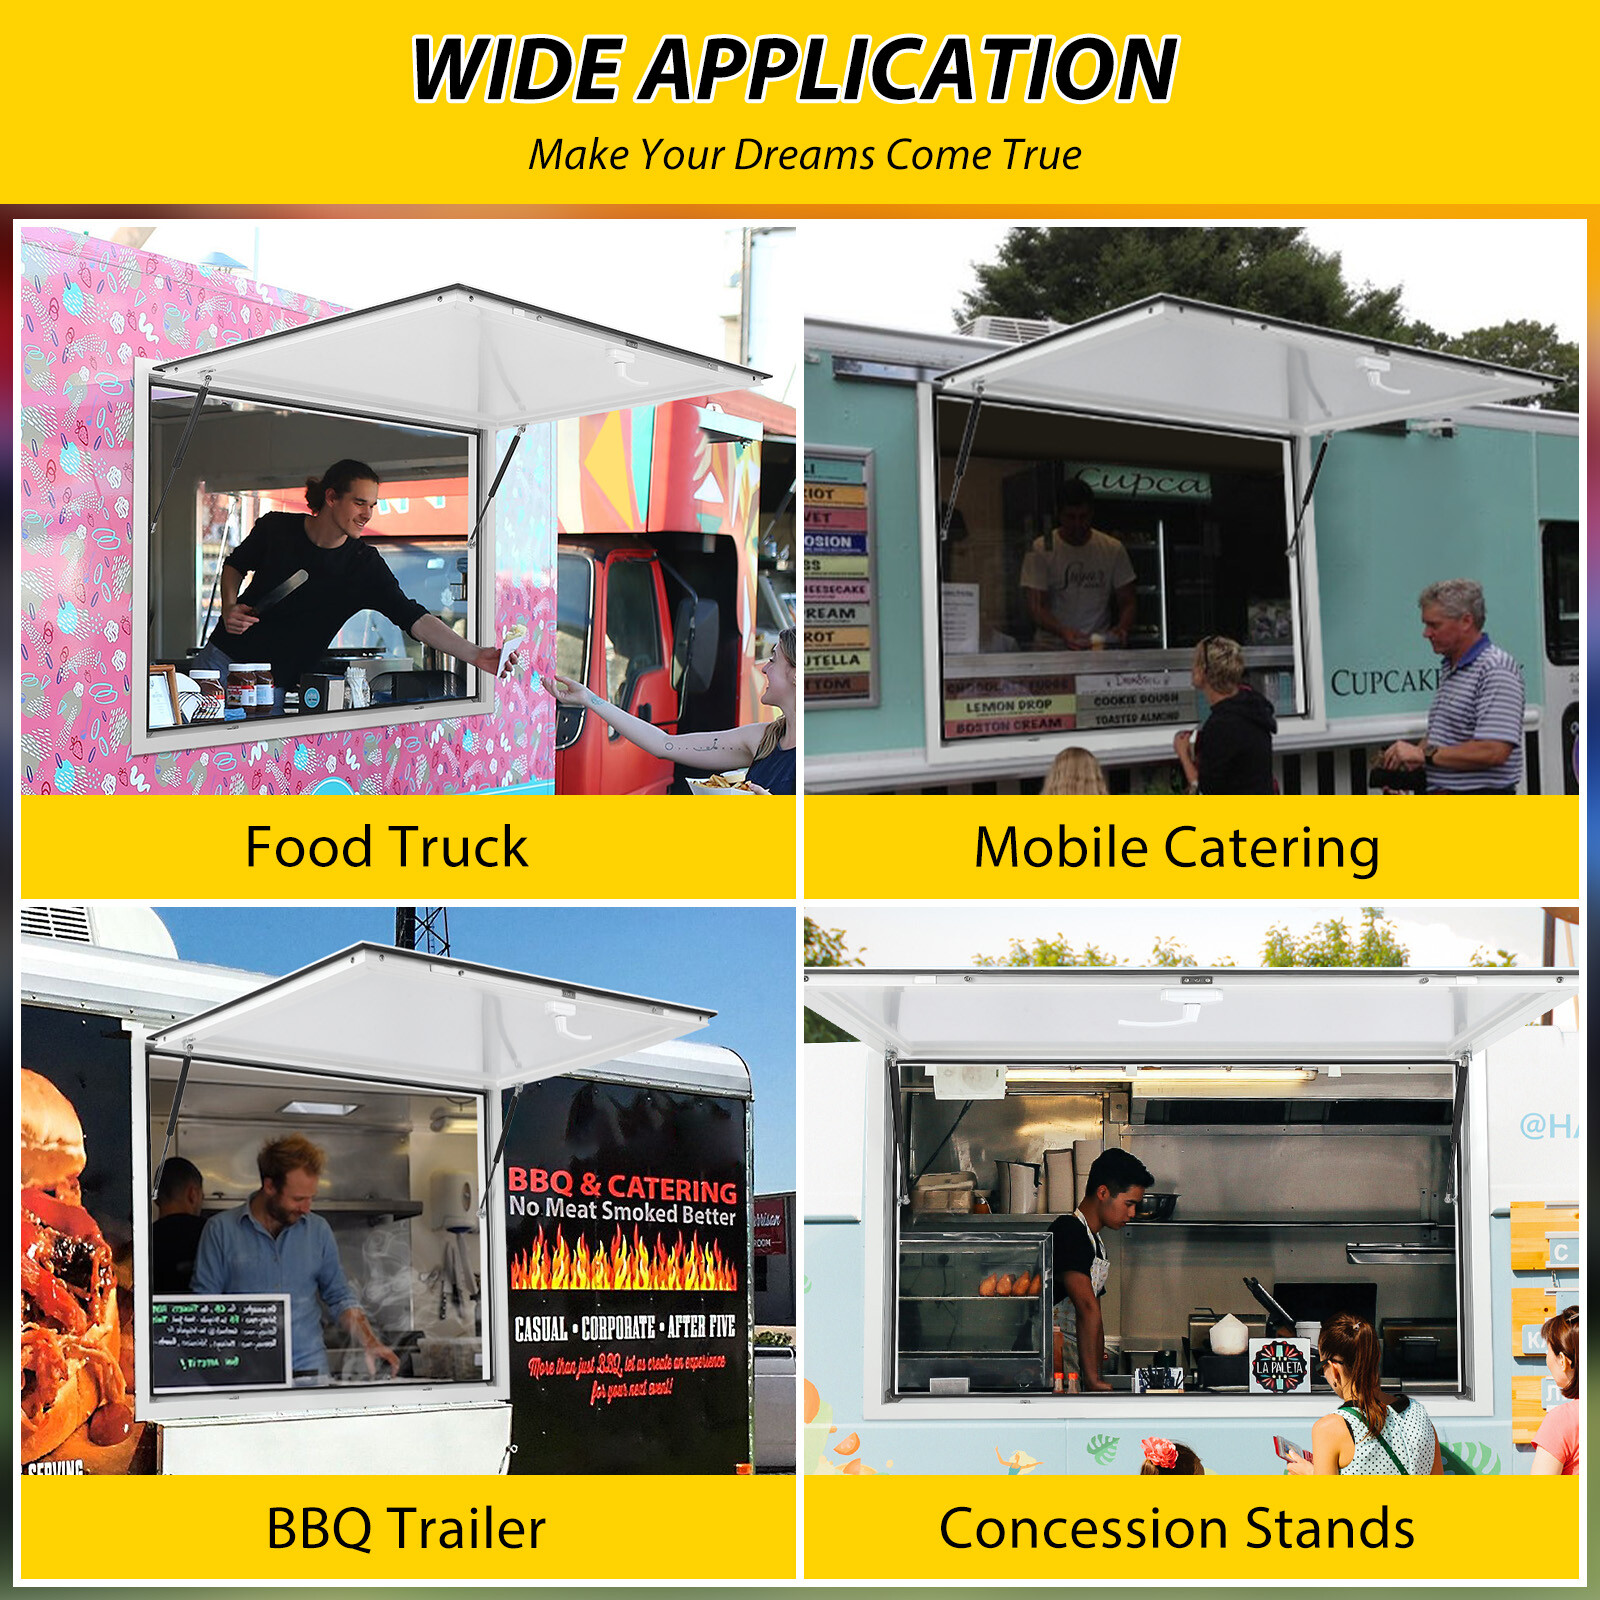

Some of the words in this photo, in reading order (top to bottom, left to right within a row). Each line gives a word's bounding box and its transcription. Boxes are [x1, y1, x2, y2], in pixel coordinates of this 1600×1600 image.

[804, 535, 852, 548] OSION
[966, 700, 1015, 713] LEMON
[1018, 698, 1053, 710] DROP
[1093, 694, 1137, 706] COOKIE
[1139, 692, 1179, 704] DOUGH
[956, 721, 1011, 734] BOSTON
[1013, 718, 1062, 730] CREAM
[508, 1167, 573, 1197] BBQ
[580, 1172, 601, 1197] &
[608, 1175, 737, 1205] CATERING
[509, 1196, 540, 1216] No
[546, 1198, 597, 1219] Meat
[602, 1201, 678, 1222] Smoked
[682, 1205, 737, 1226] Better
[515, 1316, 568, 1342] CASUAL
[581, 1315, 656, 1341] CORPORATE
[667, 1314, 706, 1339] AFTER
[709, 1314, 736, 1338] FIVE
[528, 1357, 555, 1380] More
[556, 1357, 577, 1375] than
[575, 1356, 596, 1380] just
[624, 1354, 636, 1372] let
[648, 1354, 672, 1371] create
[673, 1357, 684, 1370] an
[685, 1355, 726, 1373] experience
[1256, 1361, 1269, 1374] LA
[1271, 1361, 1304, 1374] PALETA
[590, 1380, 606, 1406] for
[607, 1383, 628, 1405] your
[629, 1379, 648, 1397] next
